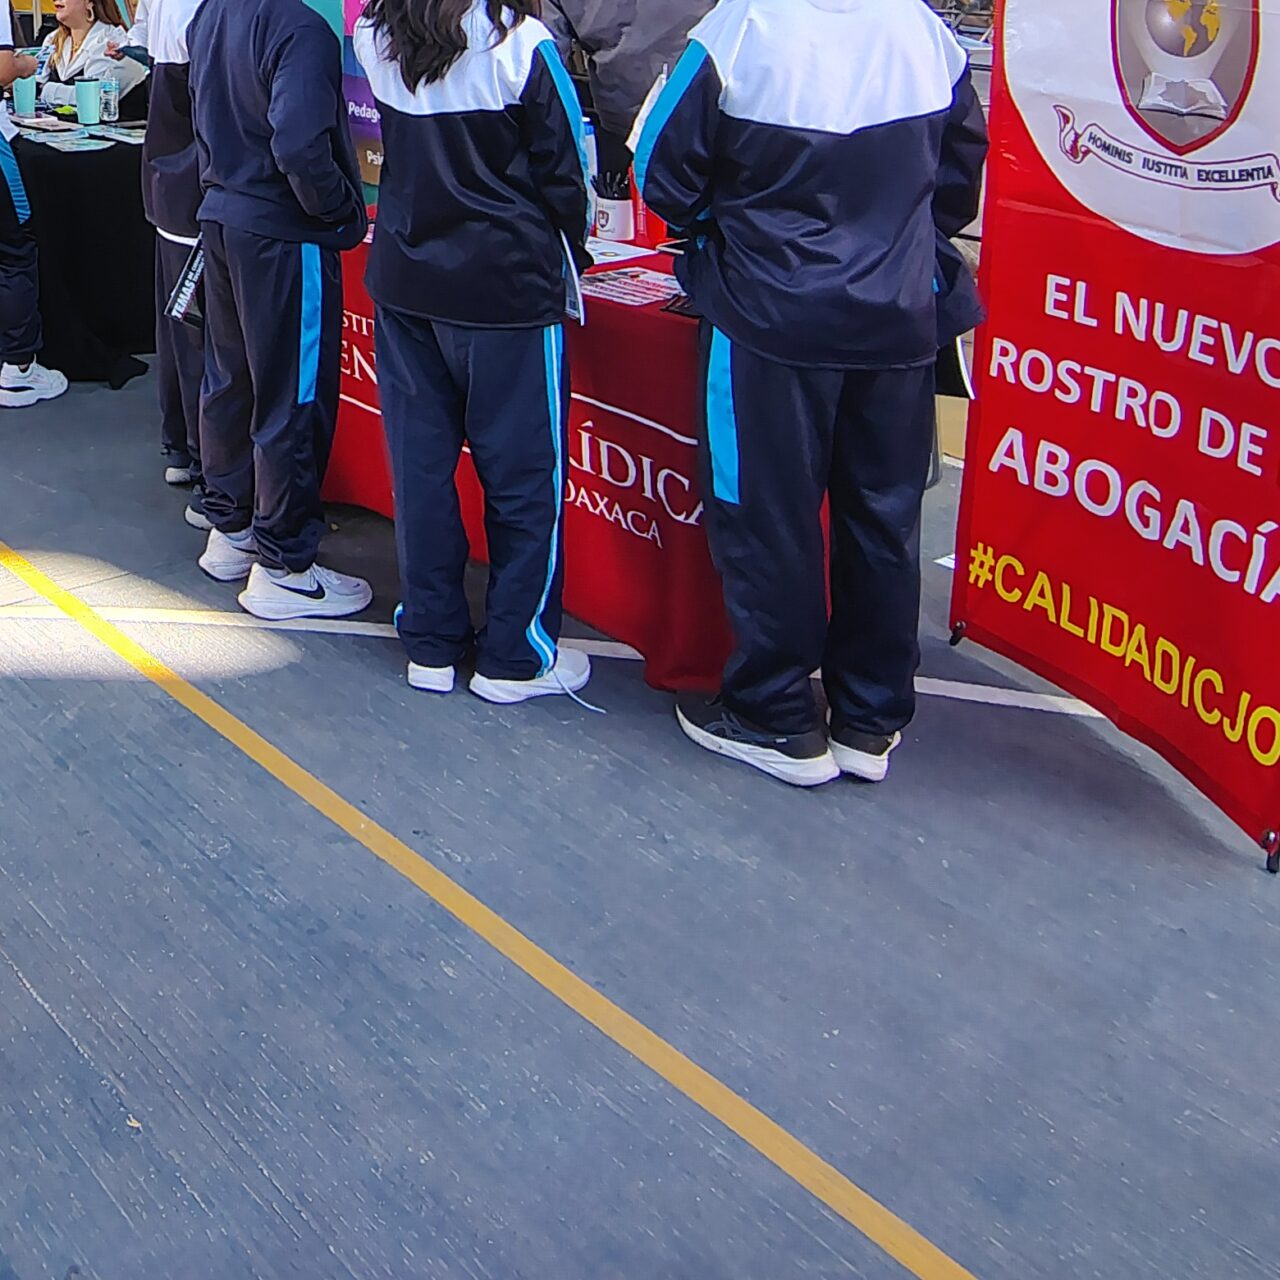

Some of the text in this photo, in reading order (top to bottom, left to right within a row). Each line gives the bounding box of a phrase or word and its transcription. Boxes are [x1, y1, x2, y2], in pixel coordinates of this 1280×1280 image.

[348, 101, 381, 123] Pedag
[1087, 131, 1275, 183] HOMINIS IUSTITIA EXCELLENTIA
[171, 279, 196, 319] TEMAS
[1044, 273, 1098, 328] EL
[988, 337, 1268, 477] ROSTRO DE
[968, 542, 1280, 767] #CALIDADICJO
